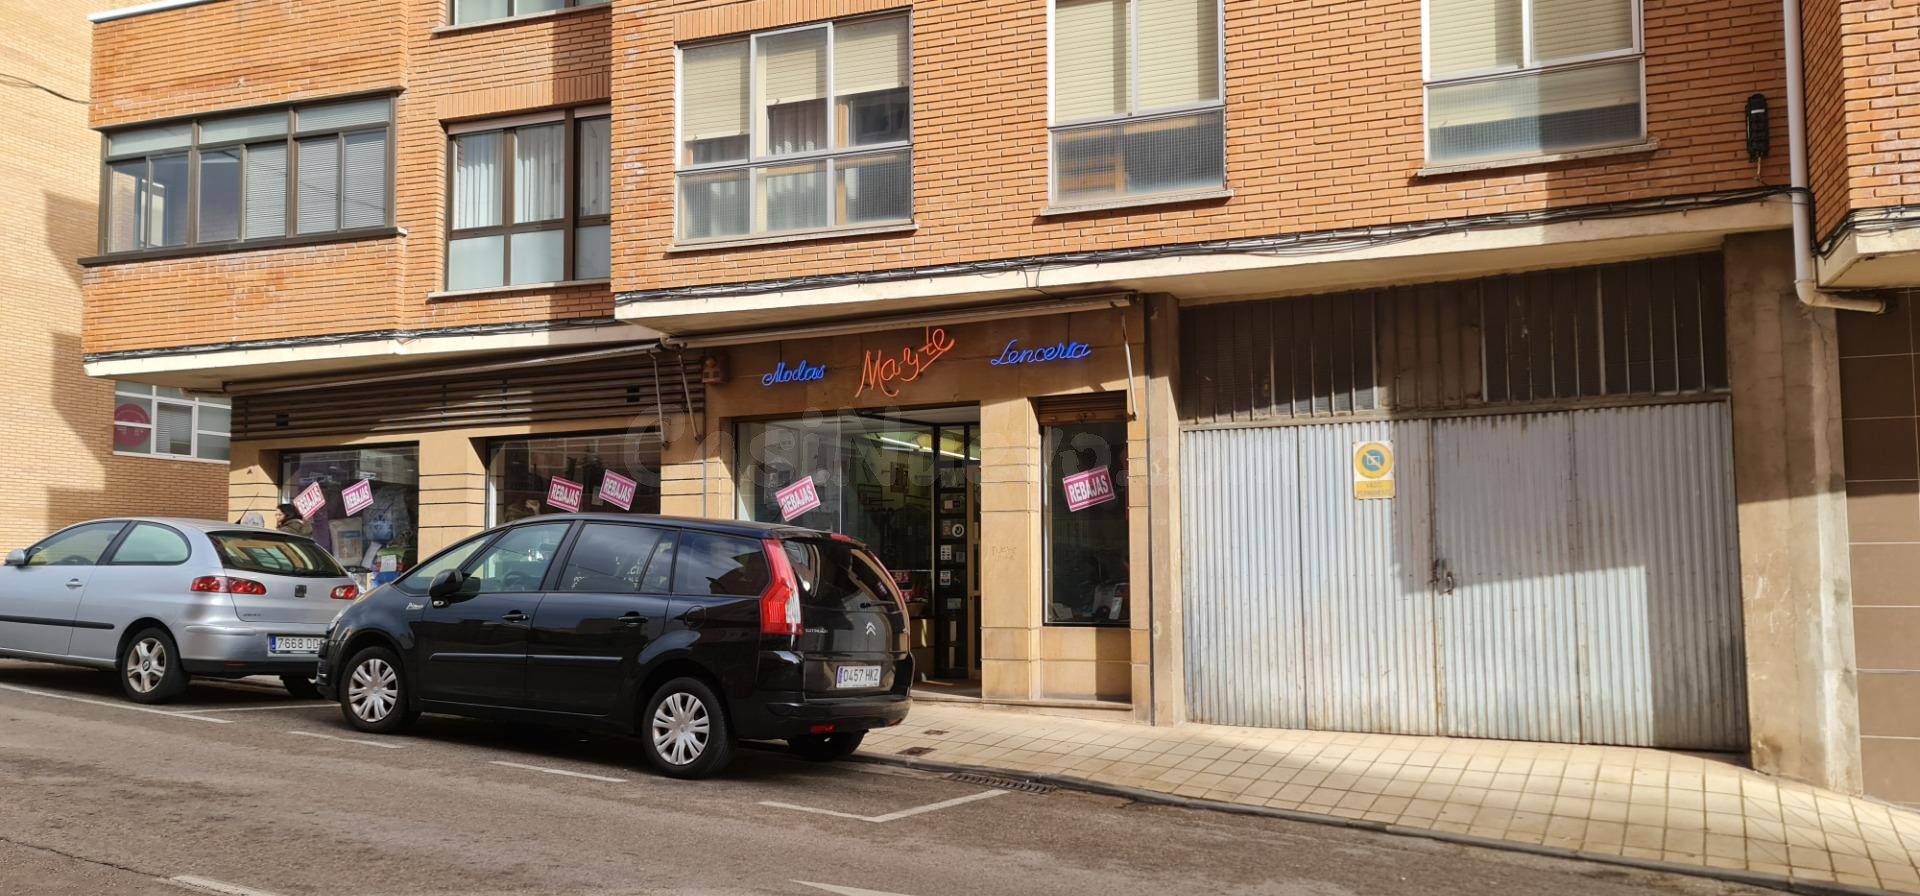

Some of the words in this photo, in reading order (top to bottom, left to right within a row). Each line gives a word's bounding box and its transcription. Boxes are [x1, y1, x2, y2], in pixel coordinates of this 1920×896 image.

[762, 360, 826, 386] Modas
[345, 485, 370, 510] REBAJAS
[550, 483, 580, 506] REBAJAS
[604, 478, 633, 502] REBAJAS
[781, 484, 814, 514] REBAJAS
[1068, 475, 1109, 503] REBAJAS
[278, 638, 303, 649] 7668
[306, 638, 320, 649] DD
[843, 669, 864, 682] 0457
[865, 668, 879, 682] HKZ
